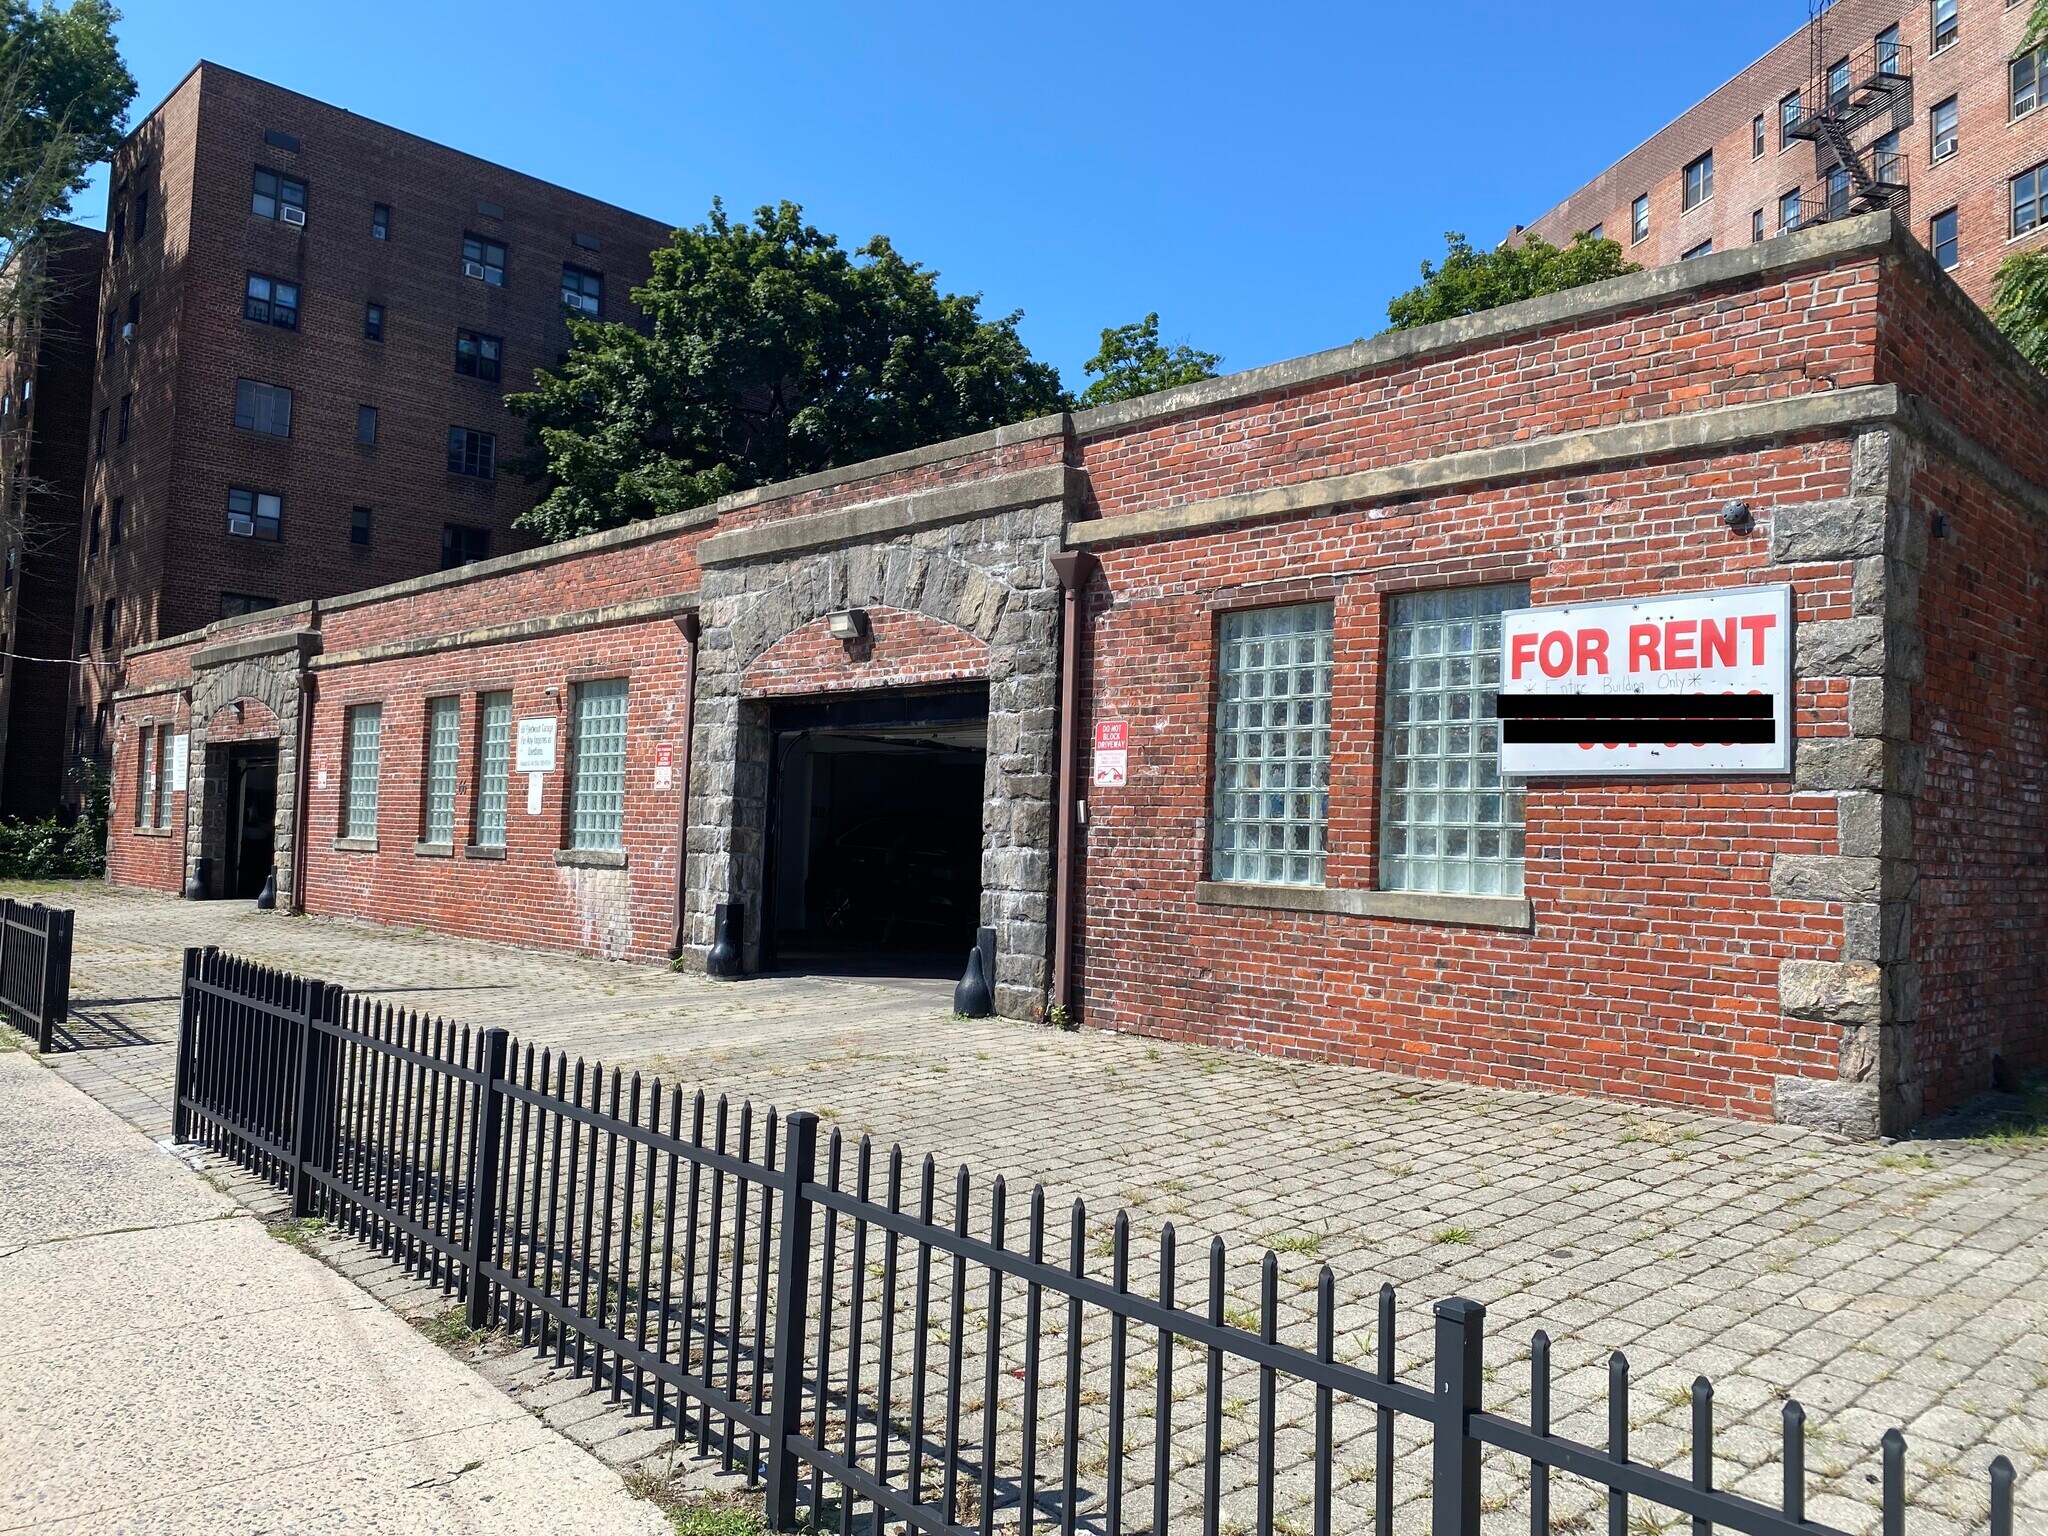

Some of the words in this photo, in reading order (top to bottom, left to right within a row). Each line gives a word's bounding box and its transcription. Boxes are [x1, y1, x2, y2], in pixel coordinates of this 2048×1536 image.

[1511, 628, 1610, 680] FOR
[1628, 614, 1777, 673] RENT
[1603, 674, 1645, 694] Building
[1657, 672, 1687, 694] Only
[1111, 724, 1122, 732] NOT
[1097, 740, 1126, 749] DRIVEWAY
